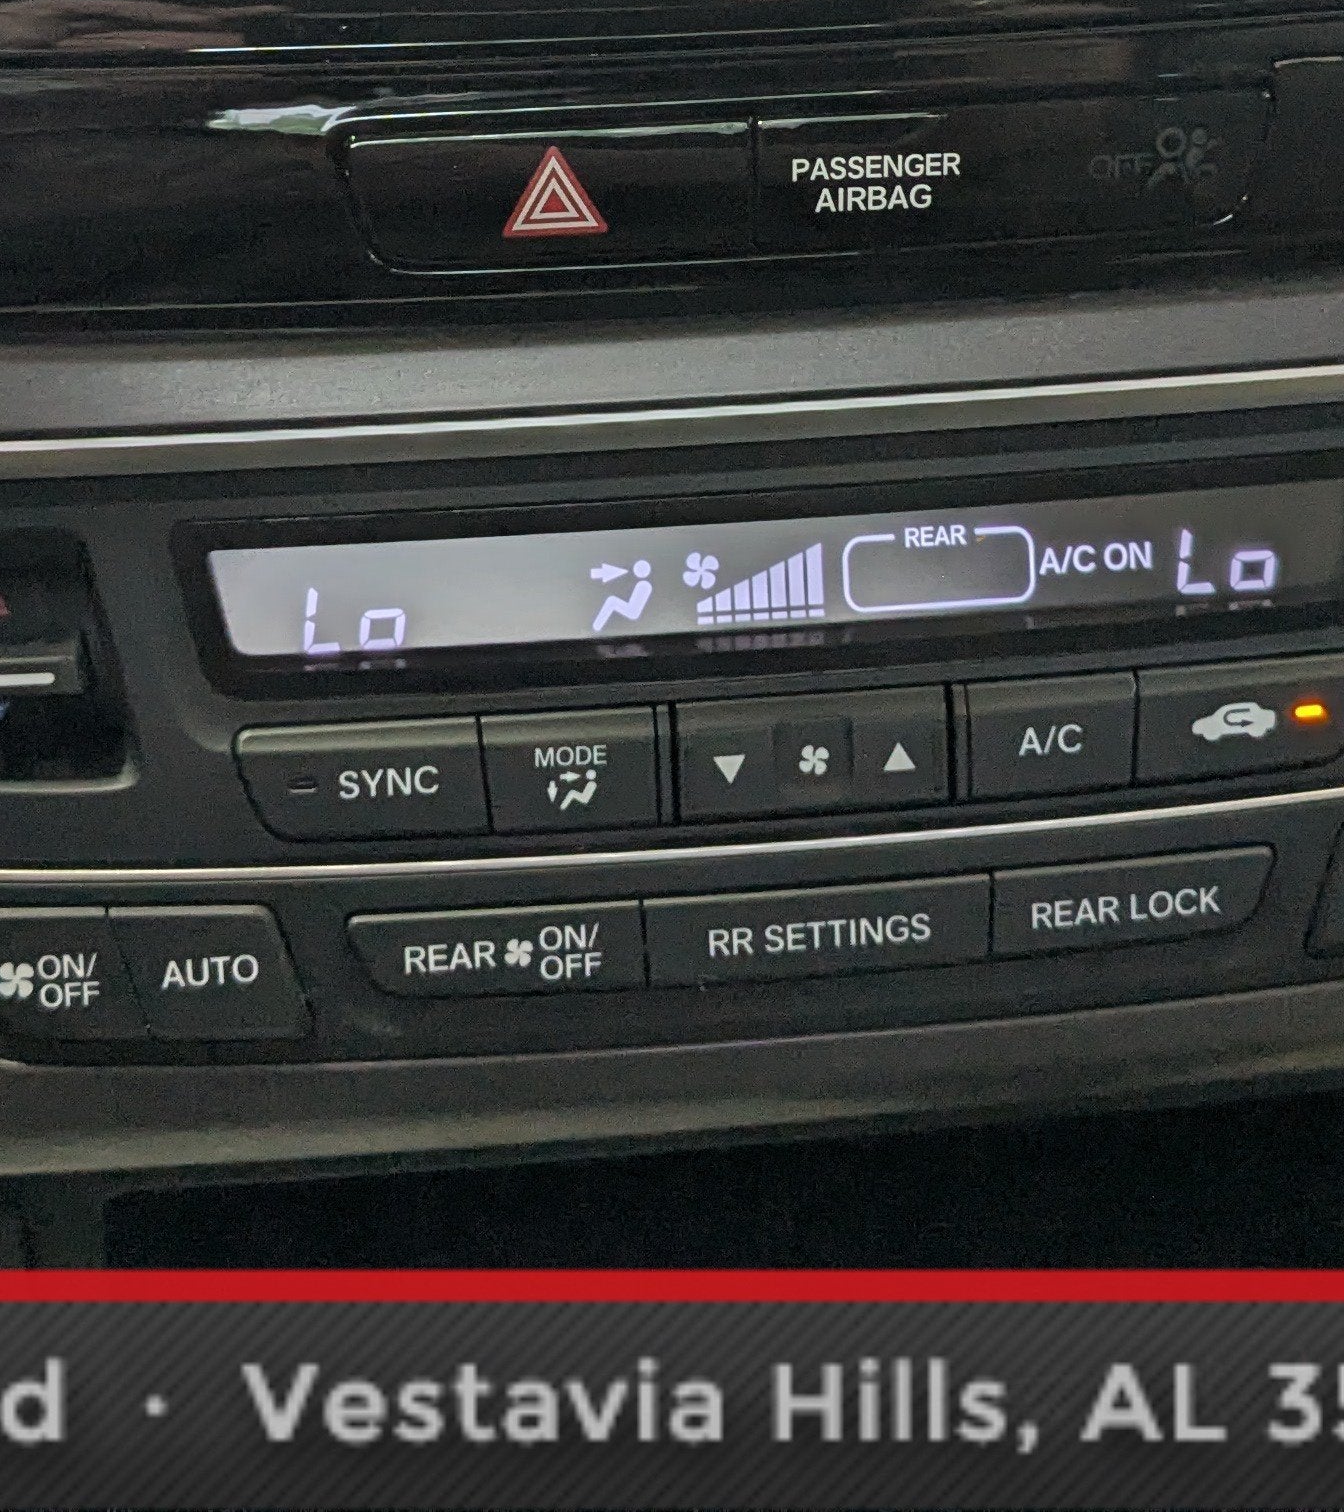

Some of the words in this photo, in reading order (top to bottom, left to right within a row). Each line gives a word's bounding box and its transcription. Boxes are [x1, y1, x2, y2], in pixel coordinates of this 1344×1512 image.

[792, 153, 960, 182] PASSENGER
[814, 184, 932, 214] AIRBAG
[903, 523, 967, 549] REAR
[1038, 543, 1098, 578] A/C
[1102, 540, 1152, 573] ON
[1017, 723, 1083, 758] A/C
[533, 744, 608, 770] MODE
[338, 766, 440, 801] SYNC
[1031, 895, 1122, 930] REAR
[1130, 886, 1220, 922] LOCK
[404, 940, 497, 974] REAR
[538, 923, 599, 952] ON/
[708, 927, 754, 958] RR
[763, 913, 931, 953] SETTINGS
[37, 952, 98, 982] ON/
[161, 953, 258, 990] AUTO
[540, 951, 603, 980] OFF
[38, 981, 100, 1009] OFF
